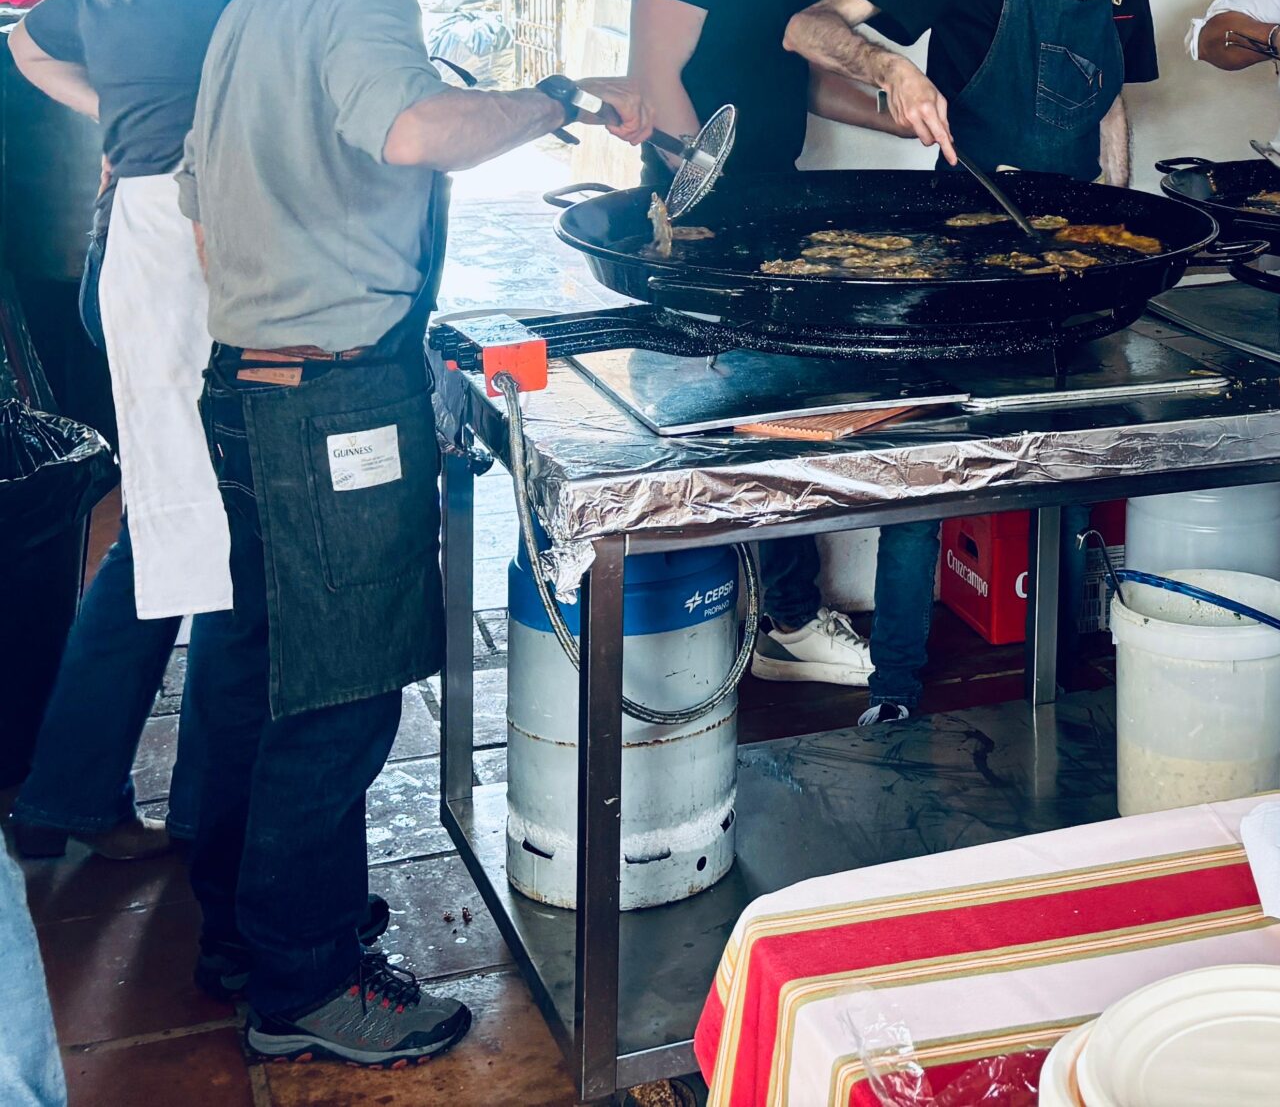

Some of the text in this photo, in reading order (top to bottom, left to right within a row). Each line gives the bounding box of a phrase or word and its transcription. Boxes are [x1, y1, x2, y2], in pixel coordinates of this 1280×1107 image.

[333, 444, 373, 459] GUINNESS
[946, 548, 989, 598] Cruzcampo
[704, 579, 735, 605] CEPSA
[703, 599, 730, 618] PROPANO
